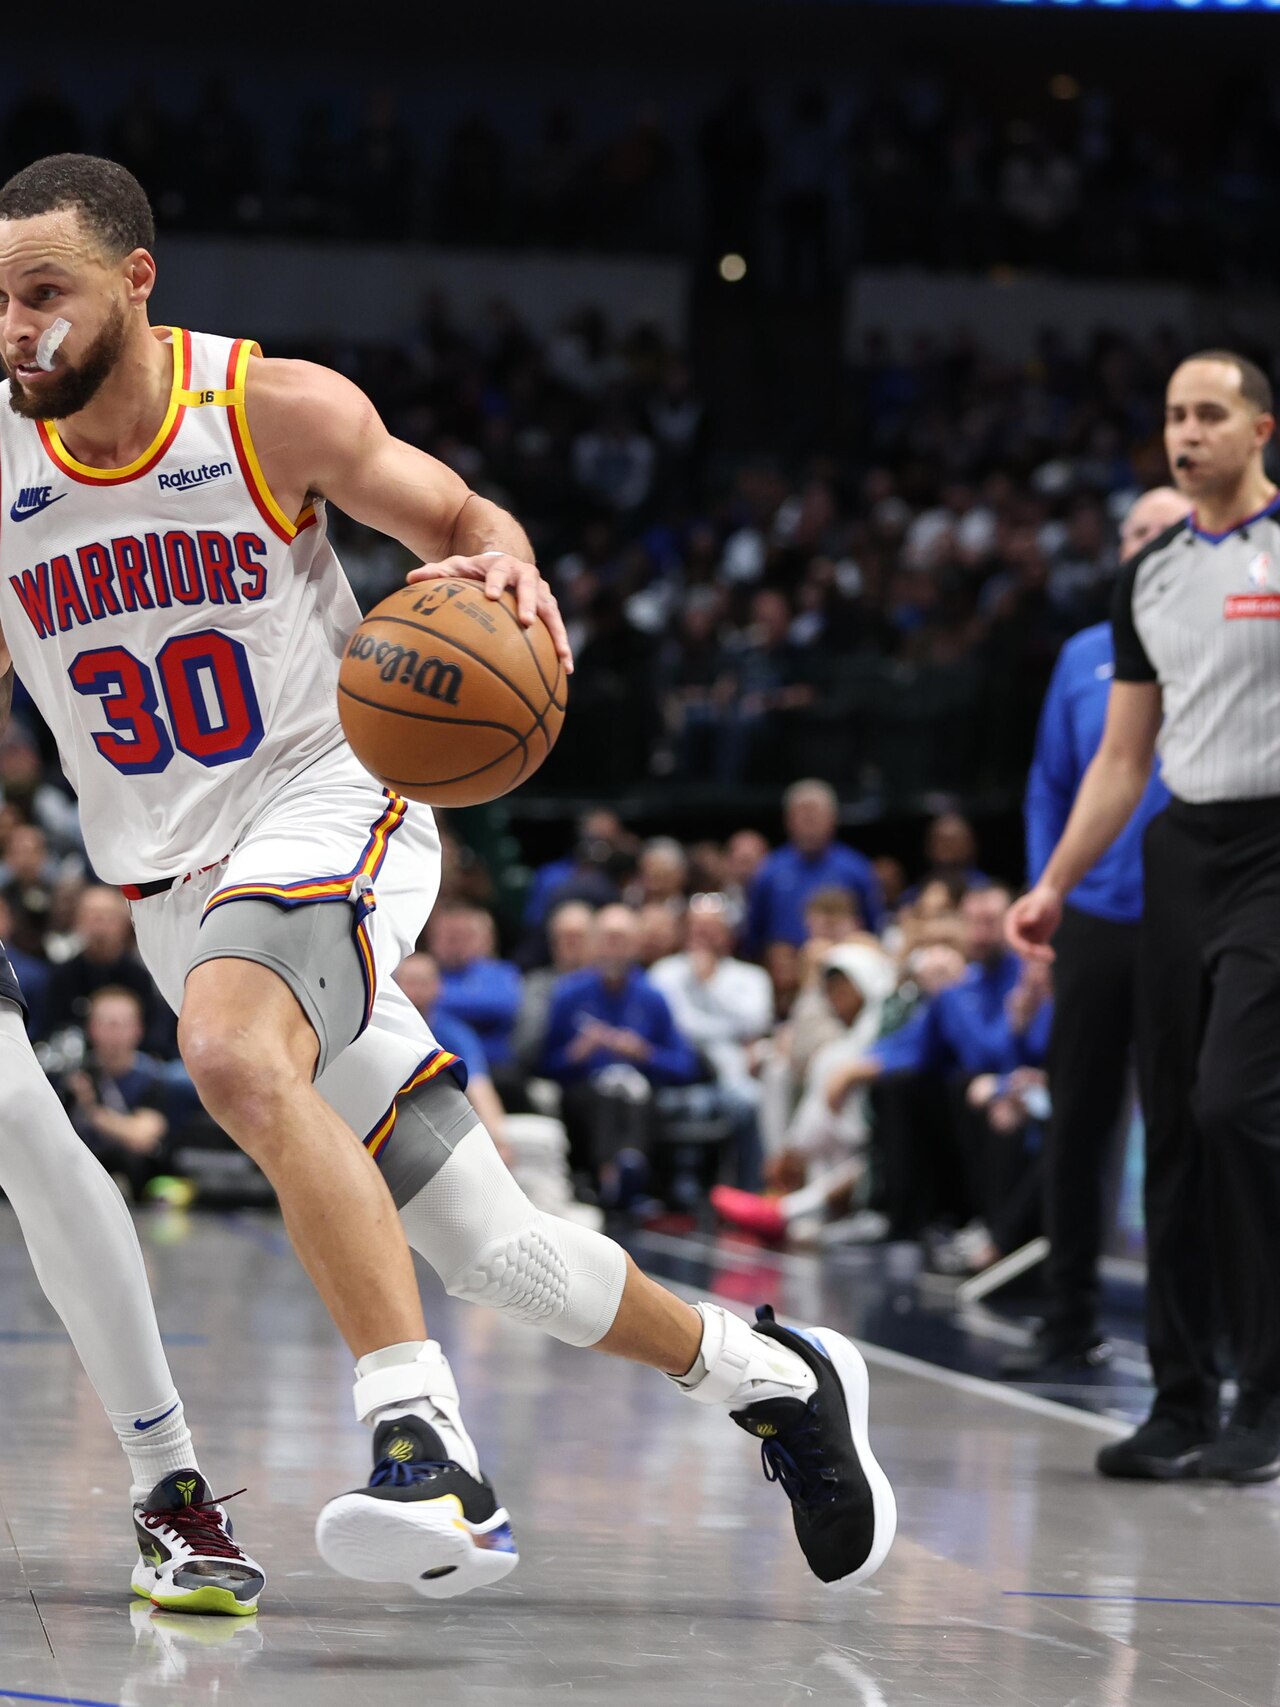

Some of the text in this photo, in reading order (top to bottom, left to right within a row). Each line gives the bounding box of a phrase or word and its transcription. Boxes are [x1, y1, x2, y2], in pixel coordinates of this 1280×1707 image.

[200, 391, 214, 404] 16
[16, 486, 52, 508] NIKE
[157, 461, 233, 491] Rakuten
[9, 531, 267, 640] WARRIORS
[347, 633, 463, 706] Wilson
[67, 629, 265, 775] 30
